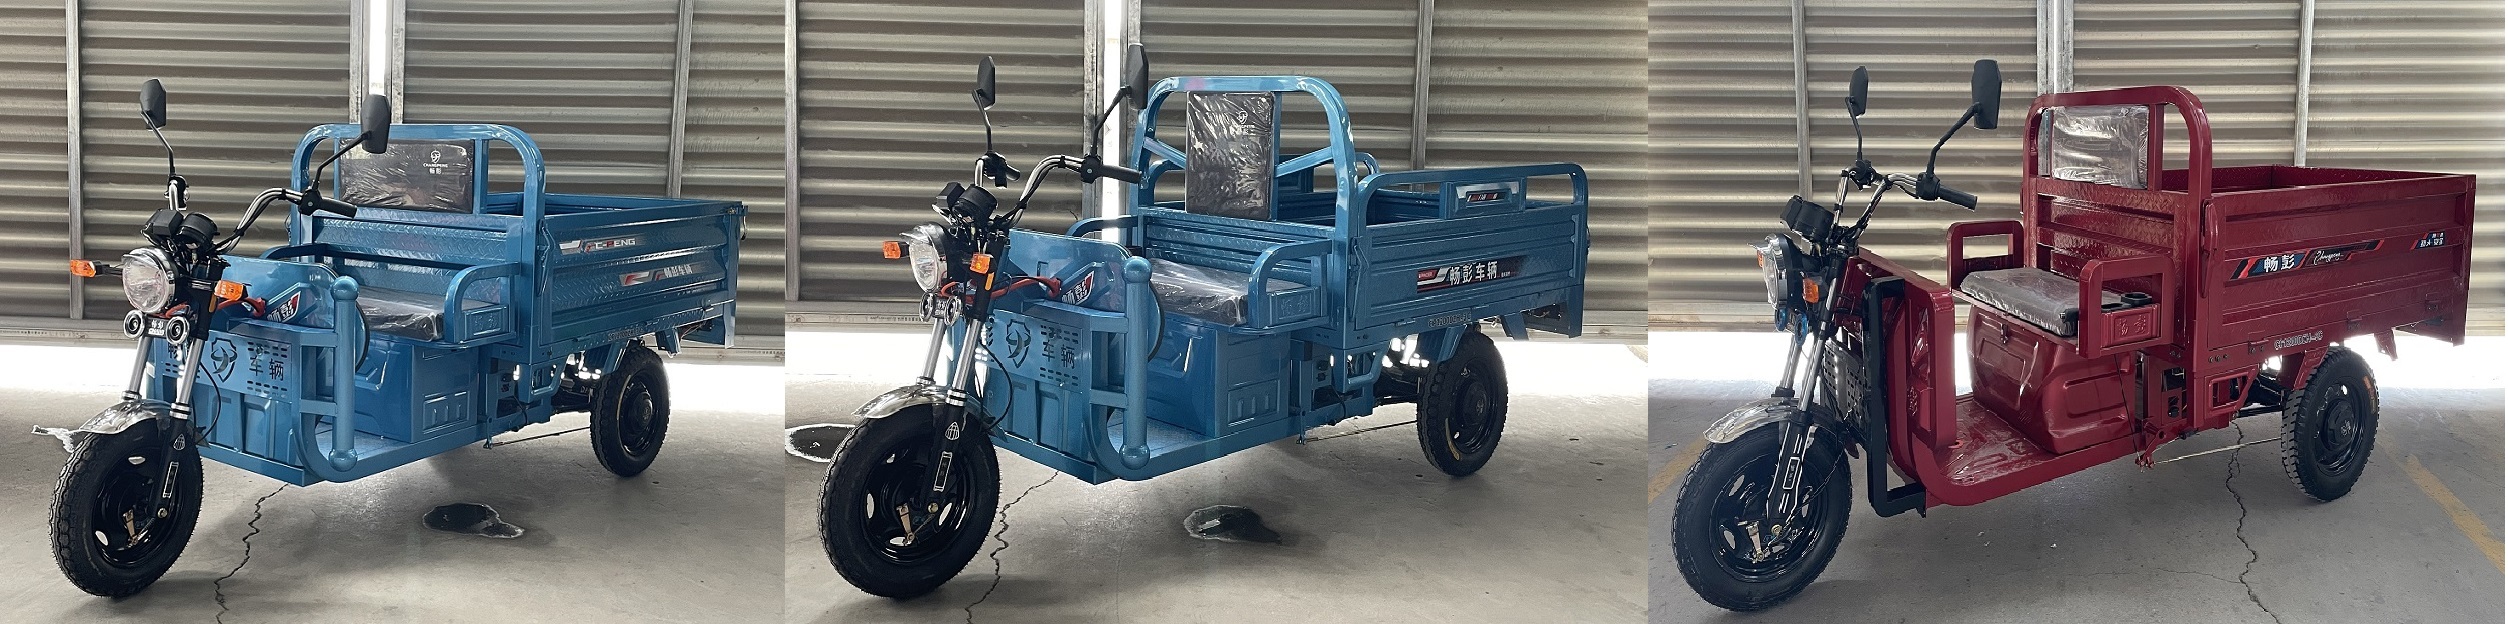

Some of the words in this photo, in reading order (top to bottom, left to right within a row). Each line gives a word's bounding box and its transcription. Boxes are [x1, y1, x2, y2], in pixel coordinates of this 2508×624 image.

[1449, 261, 1498, 286] 畅彭车辆
[2264, 254, 2295, 272] 畅彭
[248, 354, 285, 381] 车辆
[1041, 340, 1077, 370] 车辆
